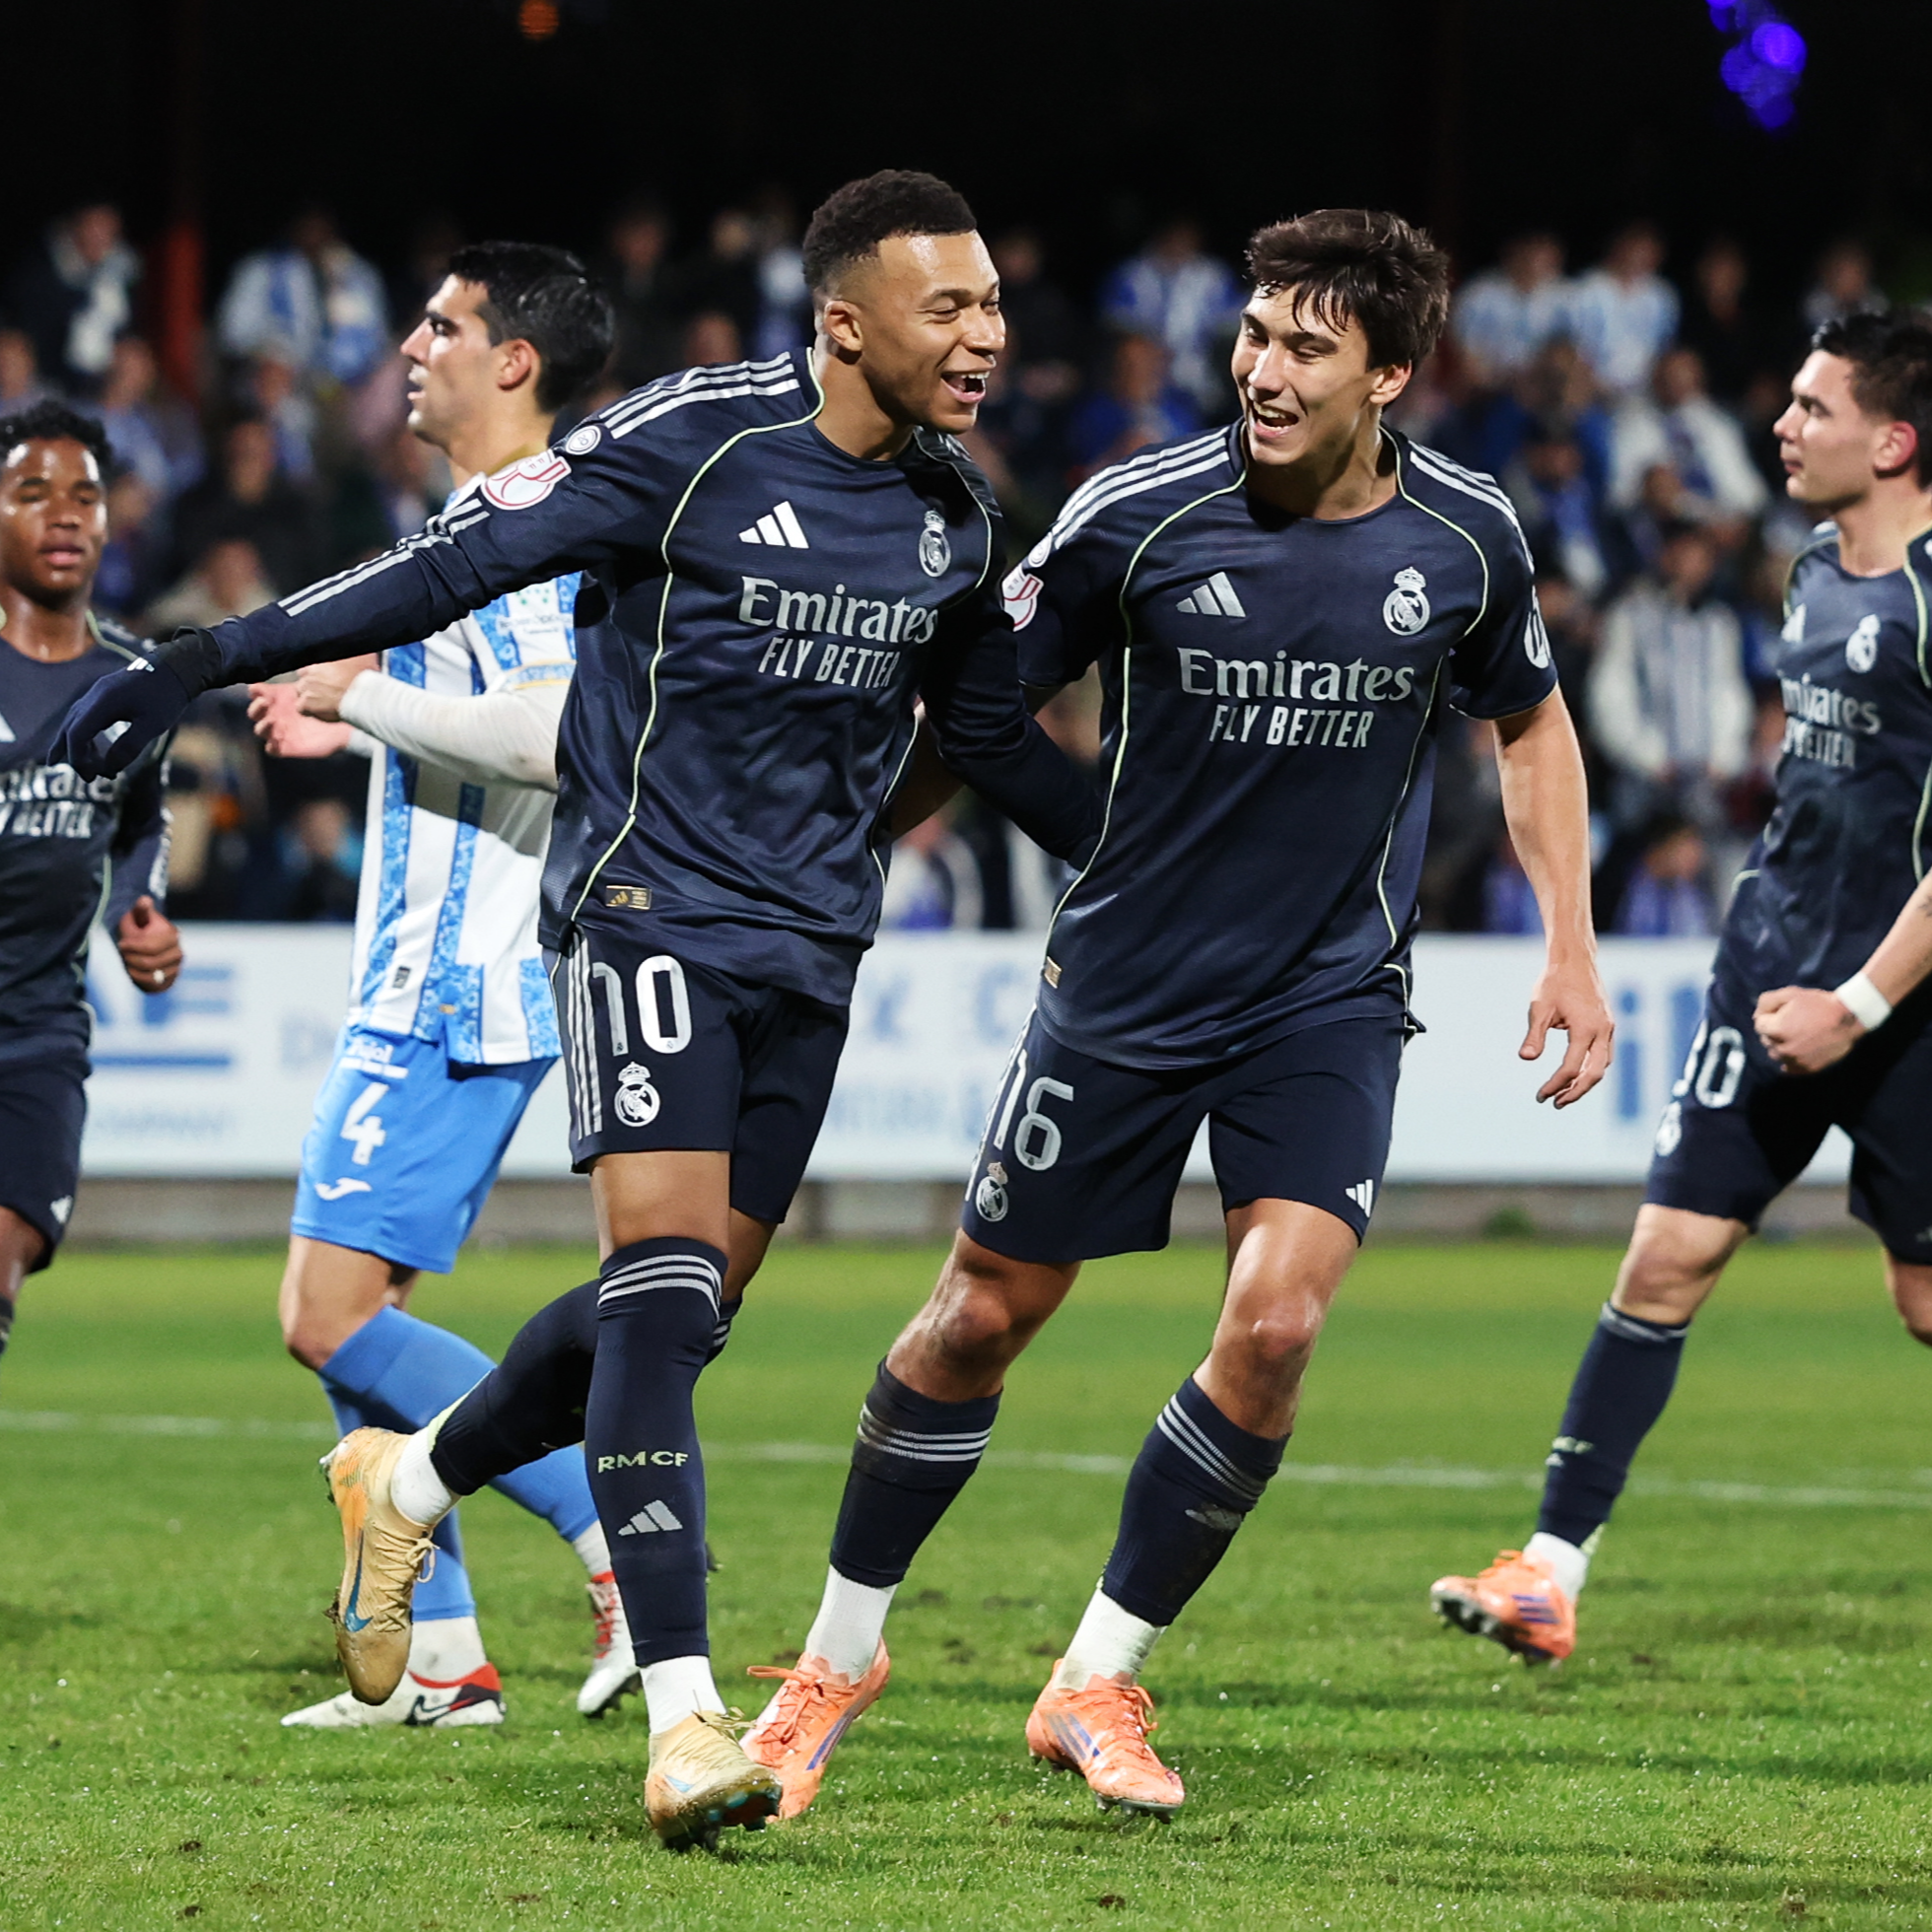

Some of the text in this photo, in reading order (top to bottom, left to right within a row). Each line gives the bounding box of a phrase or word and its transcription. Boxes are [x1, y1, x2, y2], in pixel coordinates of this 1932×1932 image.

[739, 576, 938, 644] Emirates
[758, 637, 901, 689] FLY BETTER
[1177, 647, 1414, 702] Emirates
[1209, 704, 1374, 748] FLY BETTER
[1776, 670, 1882, 735] mirates
[592, 955, 692, 1057] 10
[340, 1082, 390, 1166] 4
[993, 1049, 1074, 1171] 16
[597, 1451, 689, 1474] RMCF
